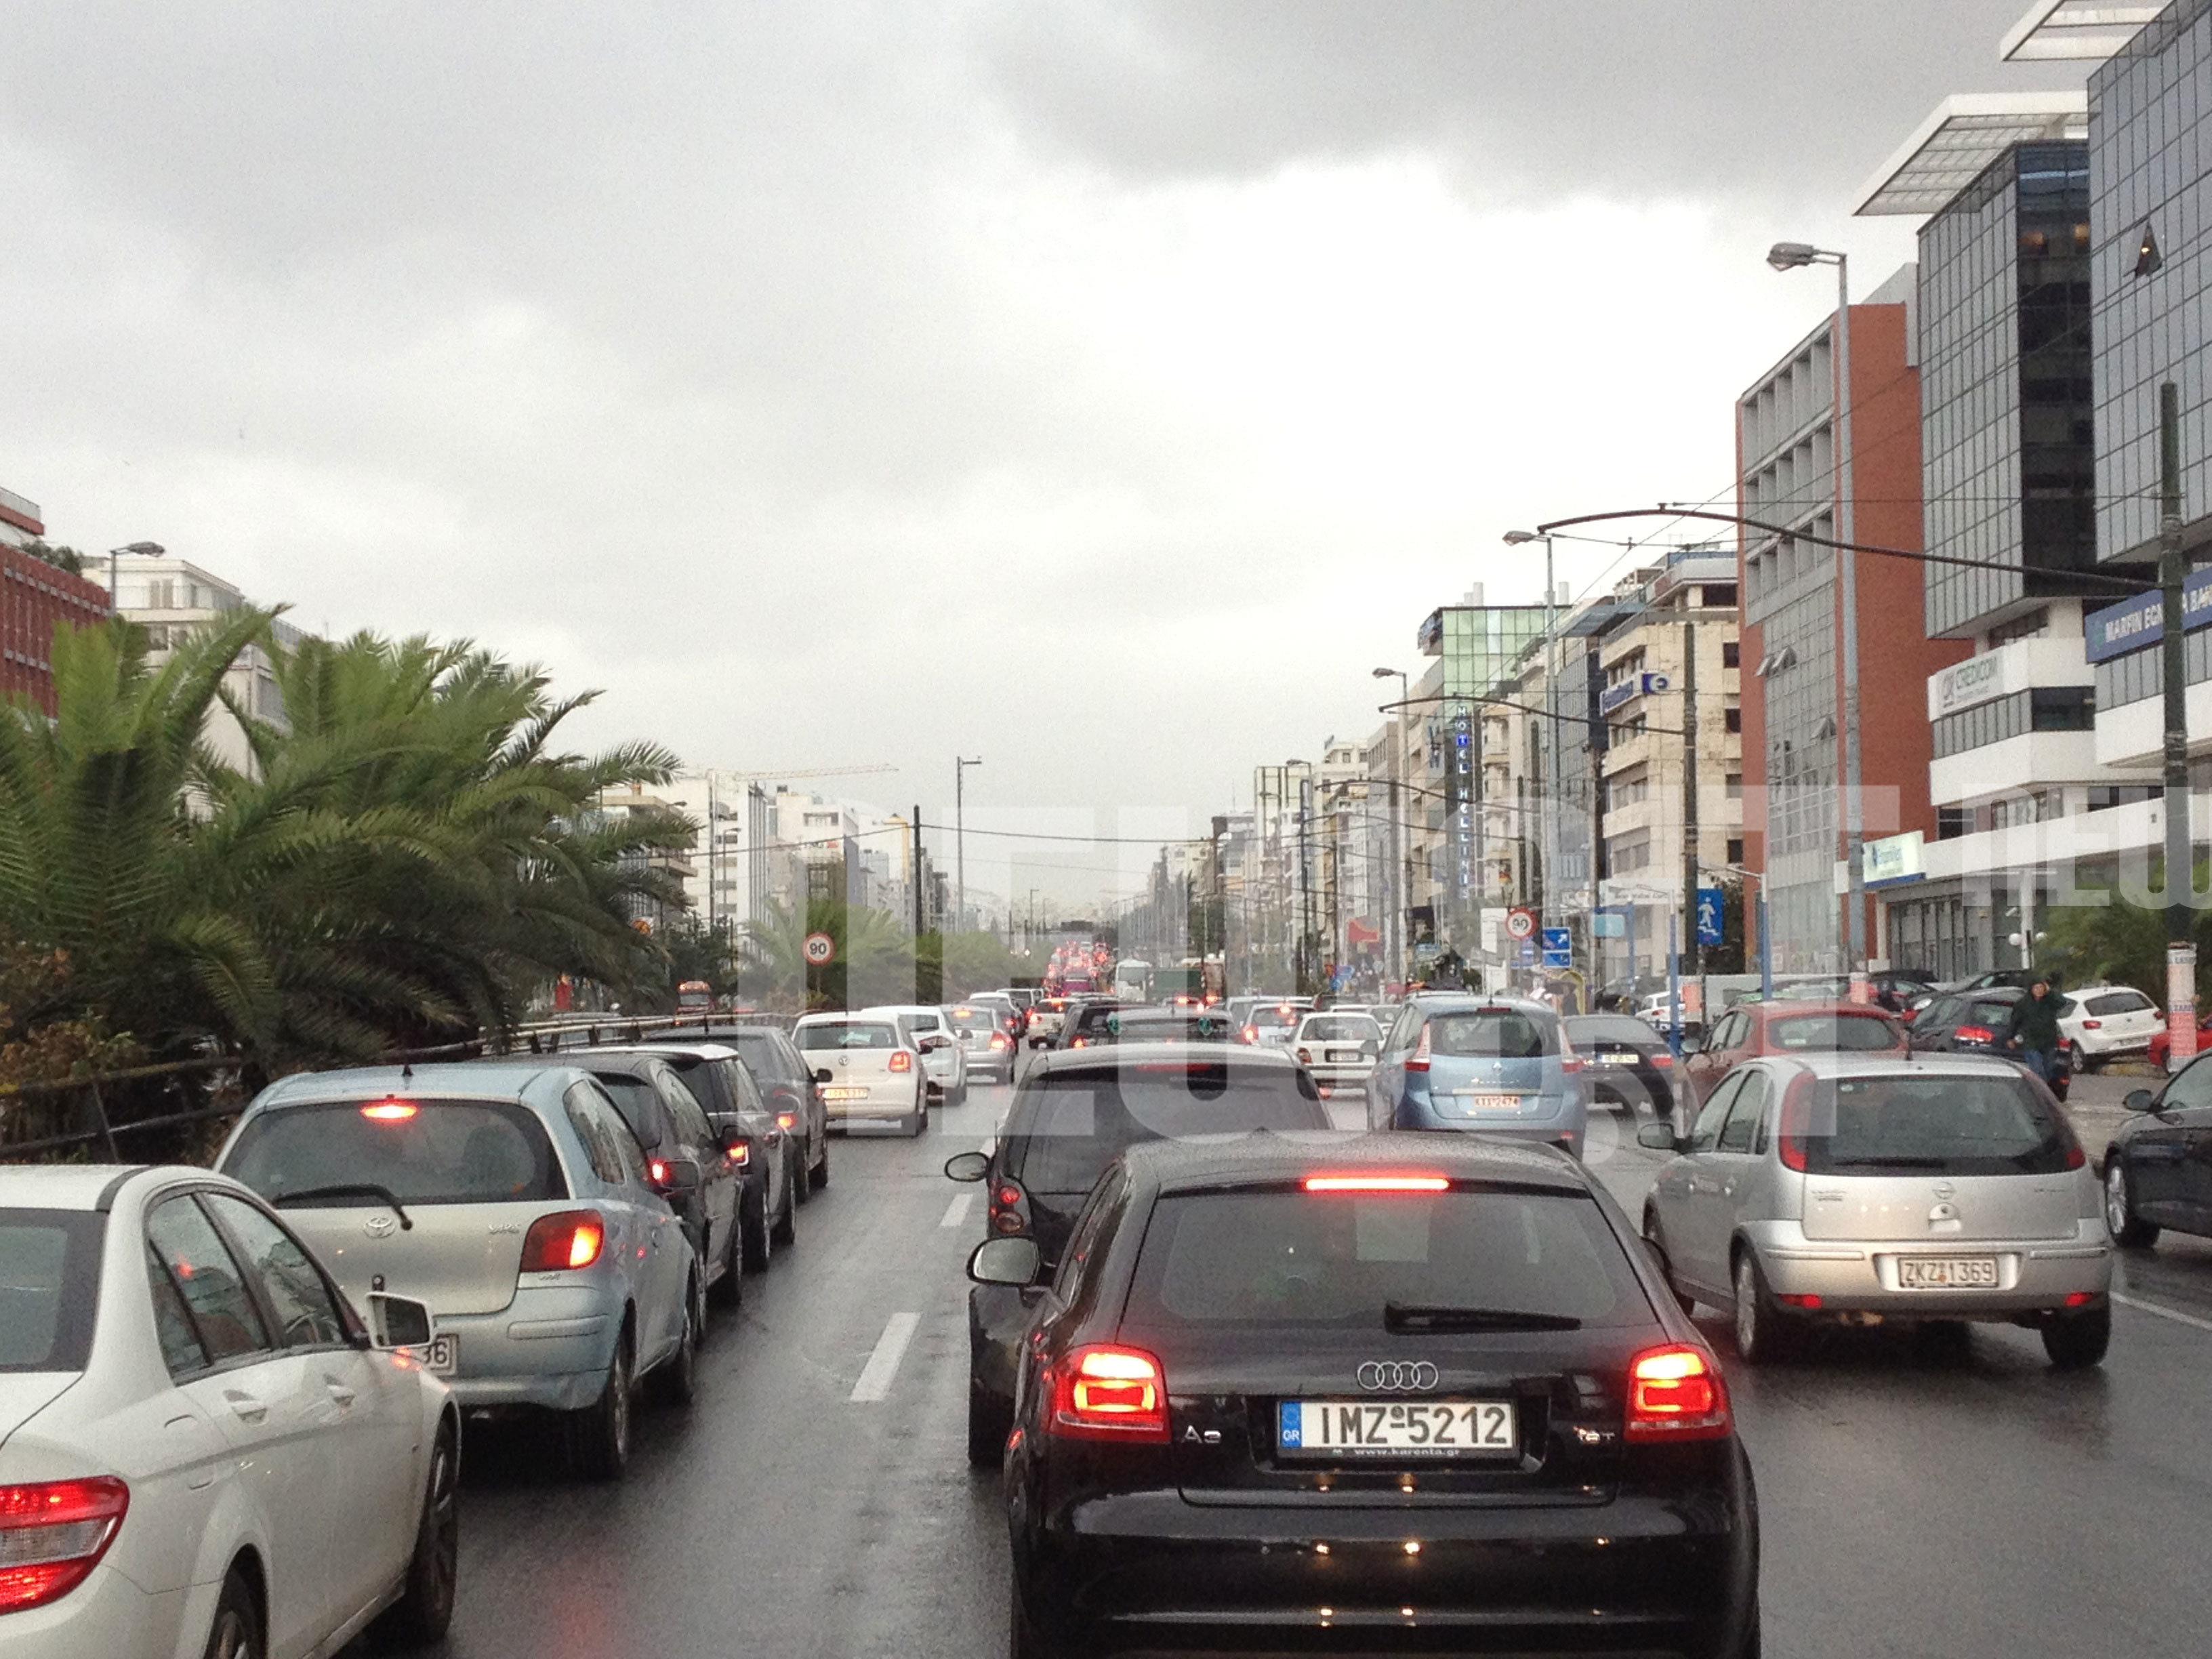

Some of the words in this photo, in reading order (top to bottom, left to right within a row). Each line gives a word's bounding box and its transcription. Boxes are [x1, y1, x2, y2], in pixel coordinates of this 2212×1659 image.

[1456, 706, 1469, 775] HOTEL
[808, 941, 827, 957] 90
[1181, 1425, 1222, 1444] A3
[1282, 1430, 1300, 1443] GR
[1353, 1448, 1460, 1458] www.karenta.gr
